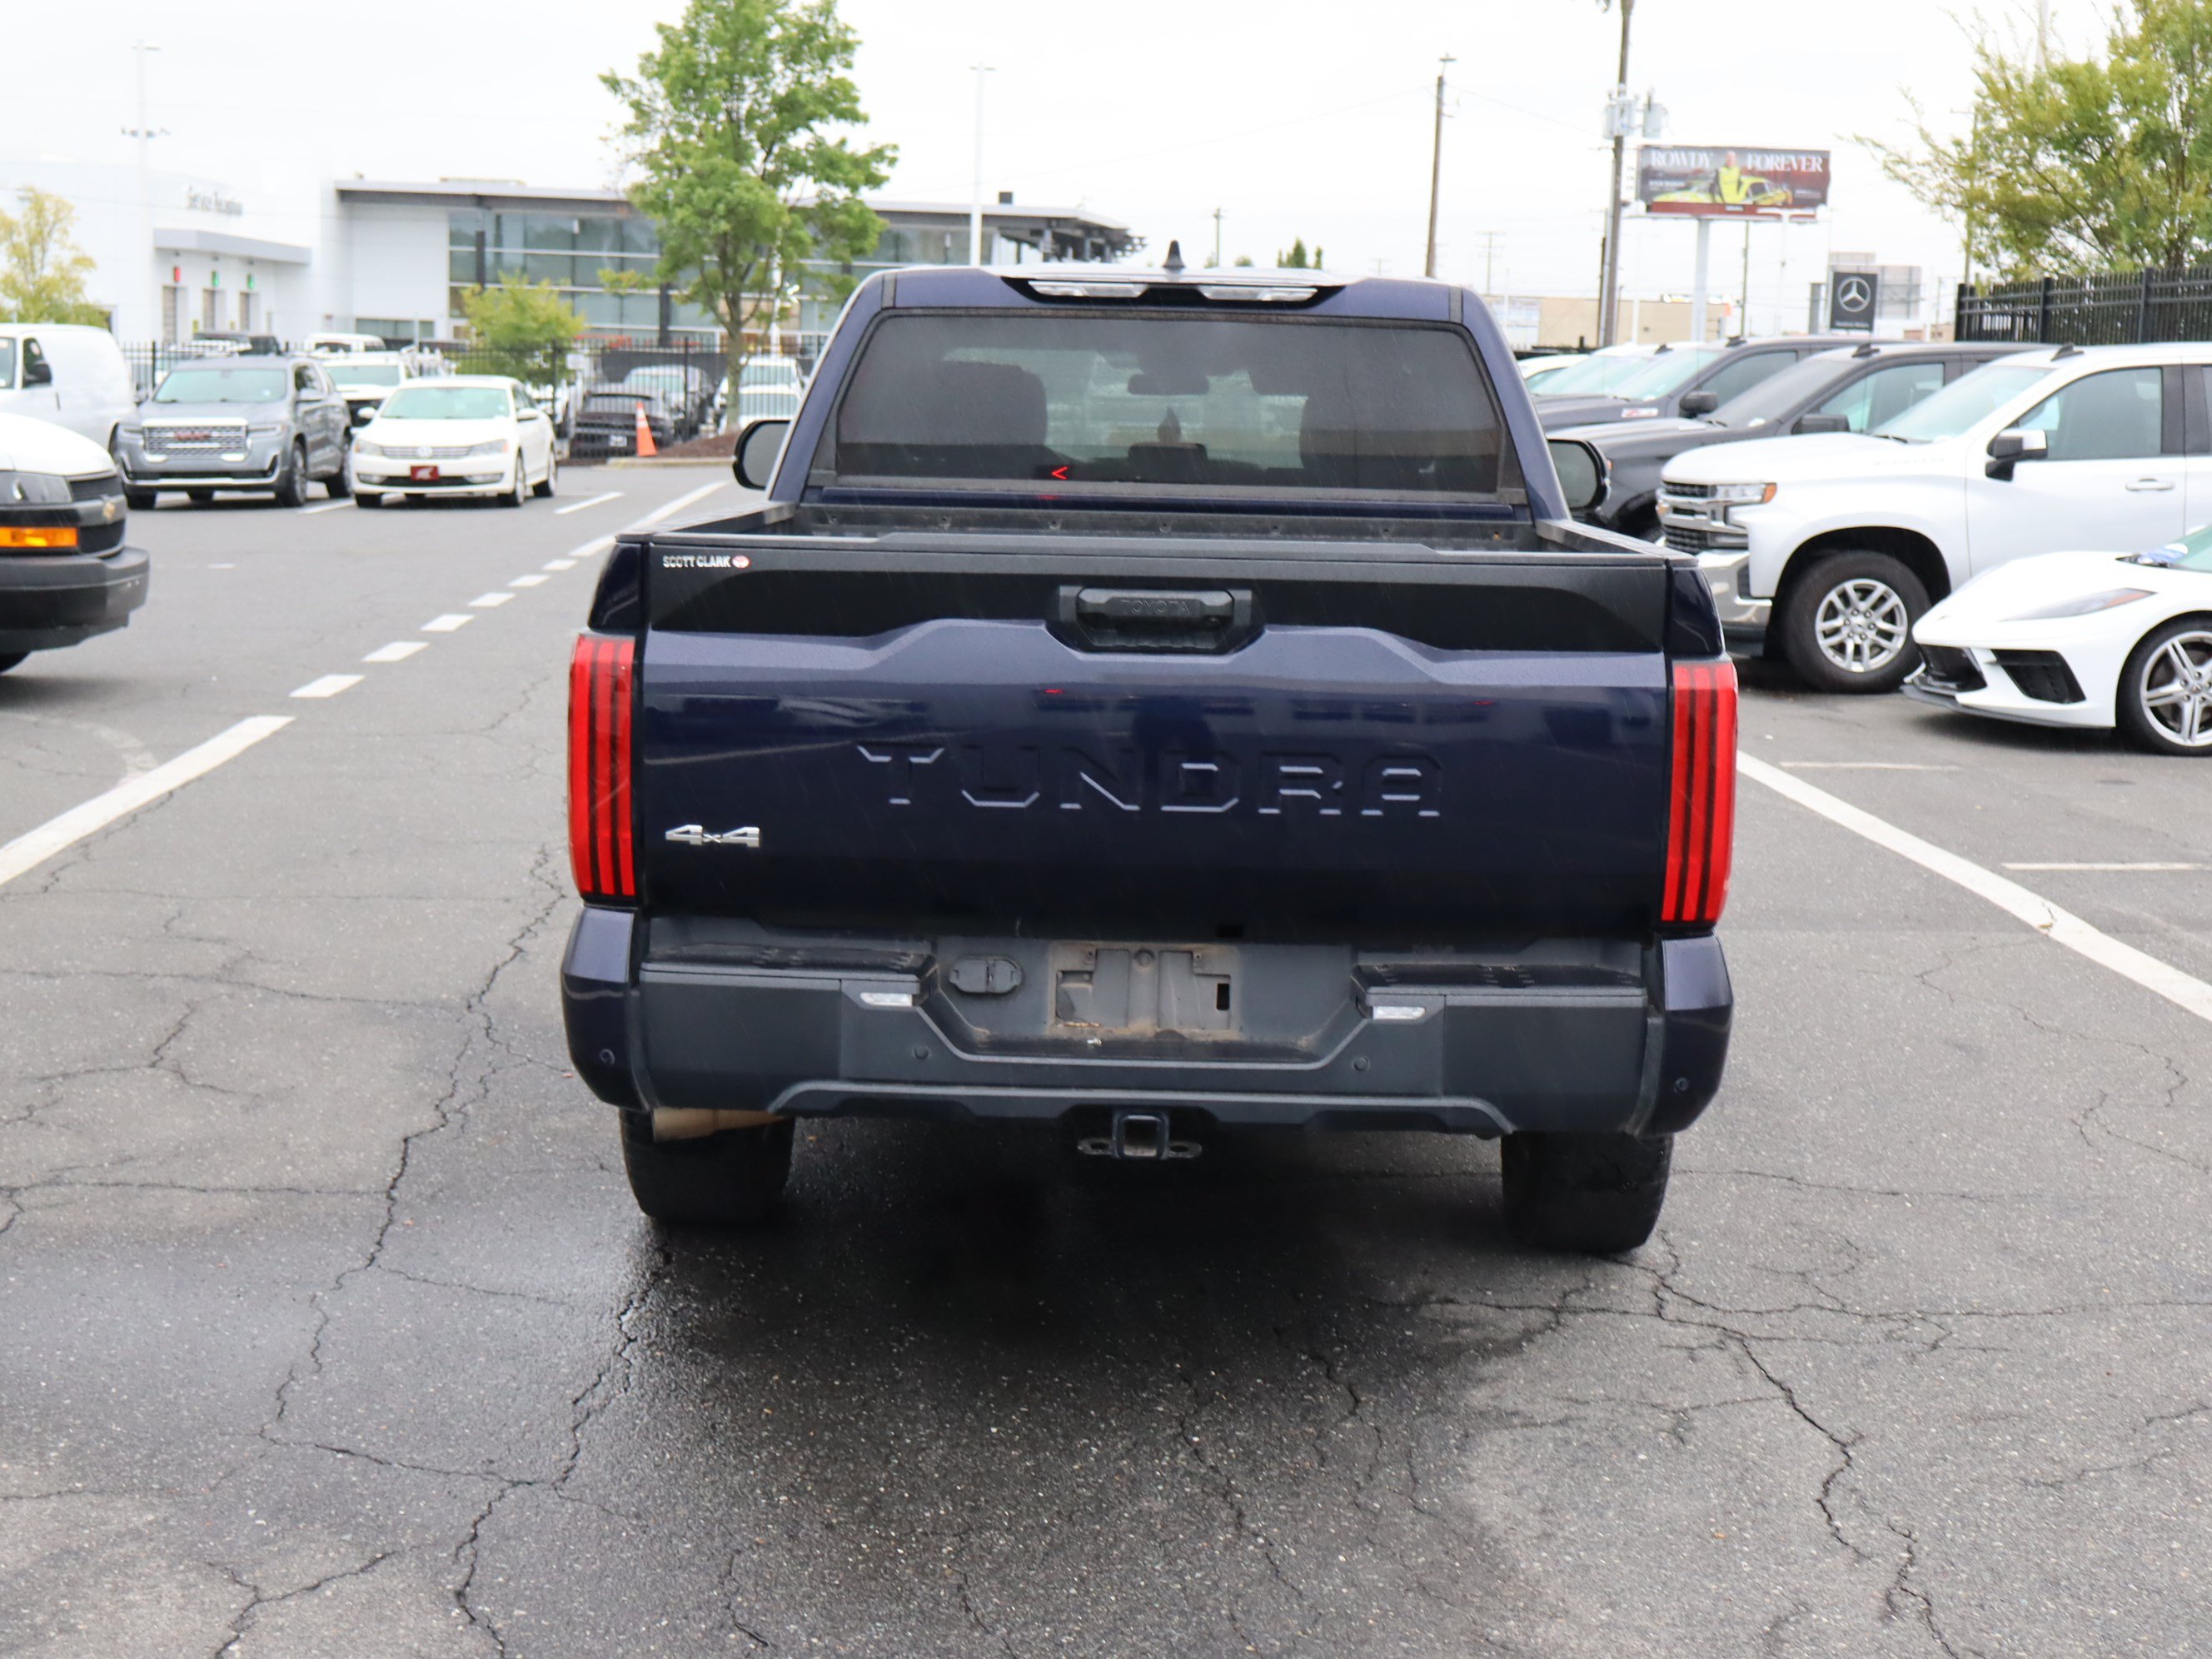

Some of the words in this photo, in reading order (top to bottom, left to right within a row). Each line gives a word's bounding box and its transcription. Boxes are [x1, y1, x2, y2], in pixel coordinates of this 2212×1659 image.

[1651, 150, 1712, 168] ROWDY
[1747, 153, 1823, 172] FOREVER
[663, 555, 695, 567] SCOTT
[696, 555, 731, 567] CLARK
[1119, 599, 1191, 615] TOYOTA
[857, 744, 1442, 817] TUNDRA
